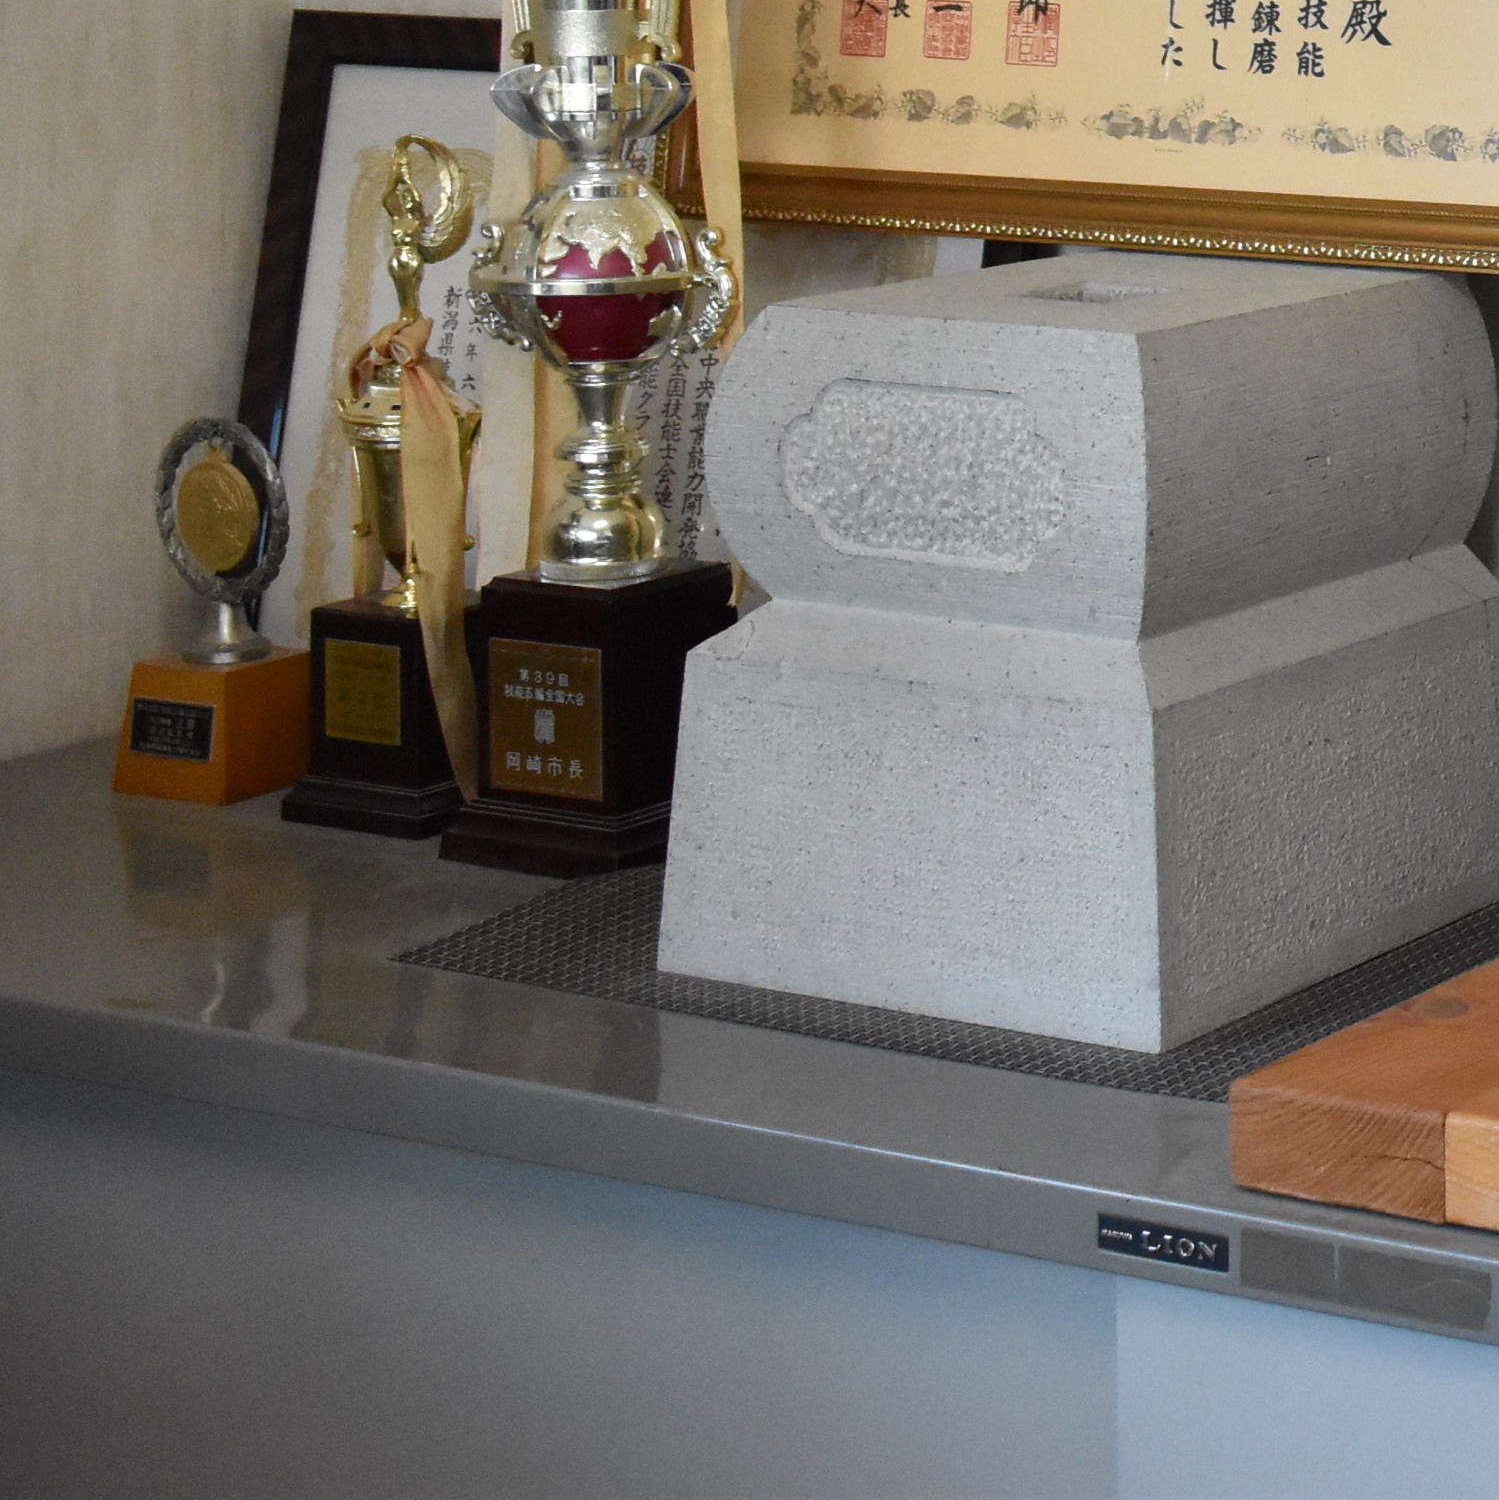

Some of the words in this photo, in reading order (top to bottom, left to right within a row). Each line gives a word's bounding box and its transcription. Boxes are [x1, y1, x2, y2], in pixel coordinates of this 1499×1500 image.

[506, 751, 584, 779] 岡崎市長
[1141, 1230, 1219, 1263] LION
